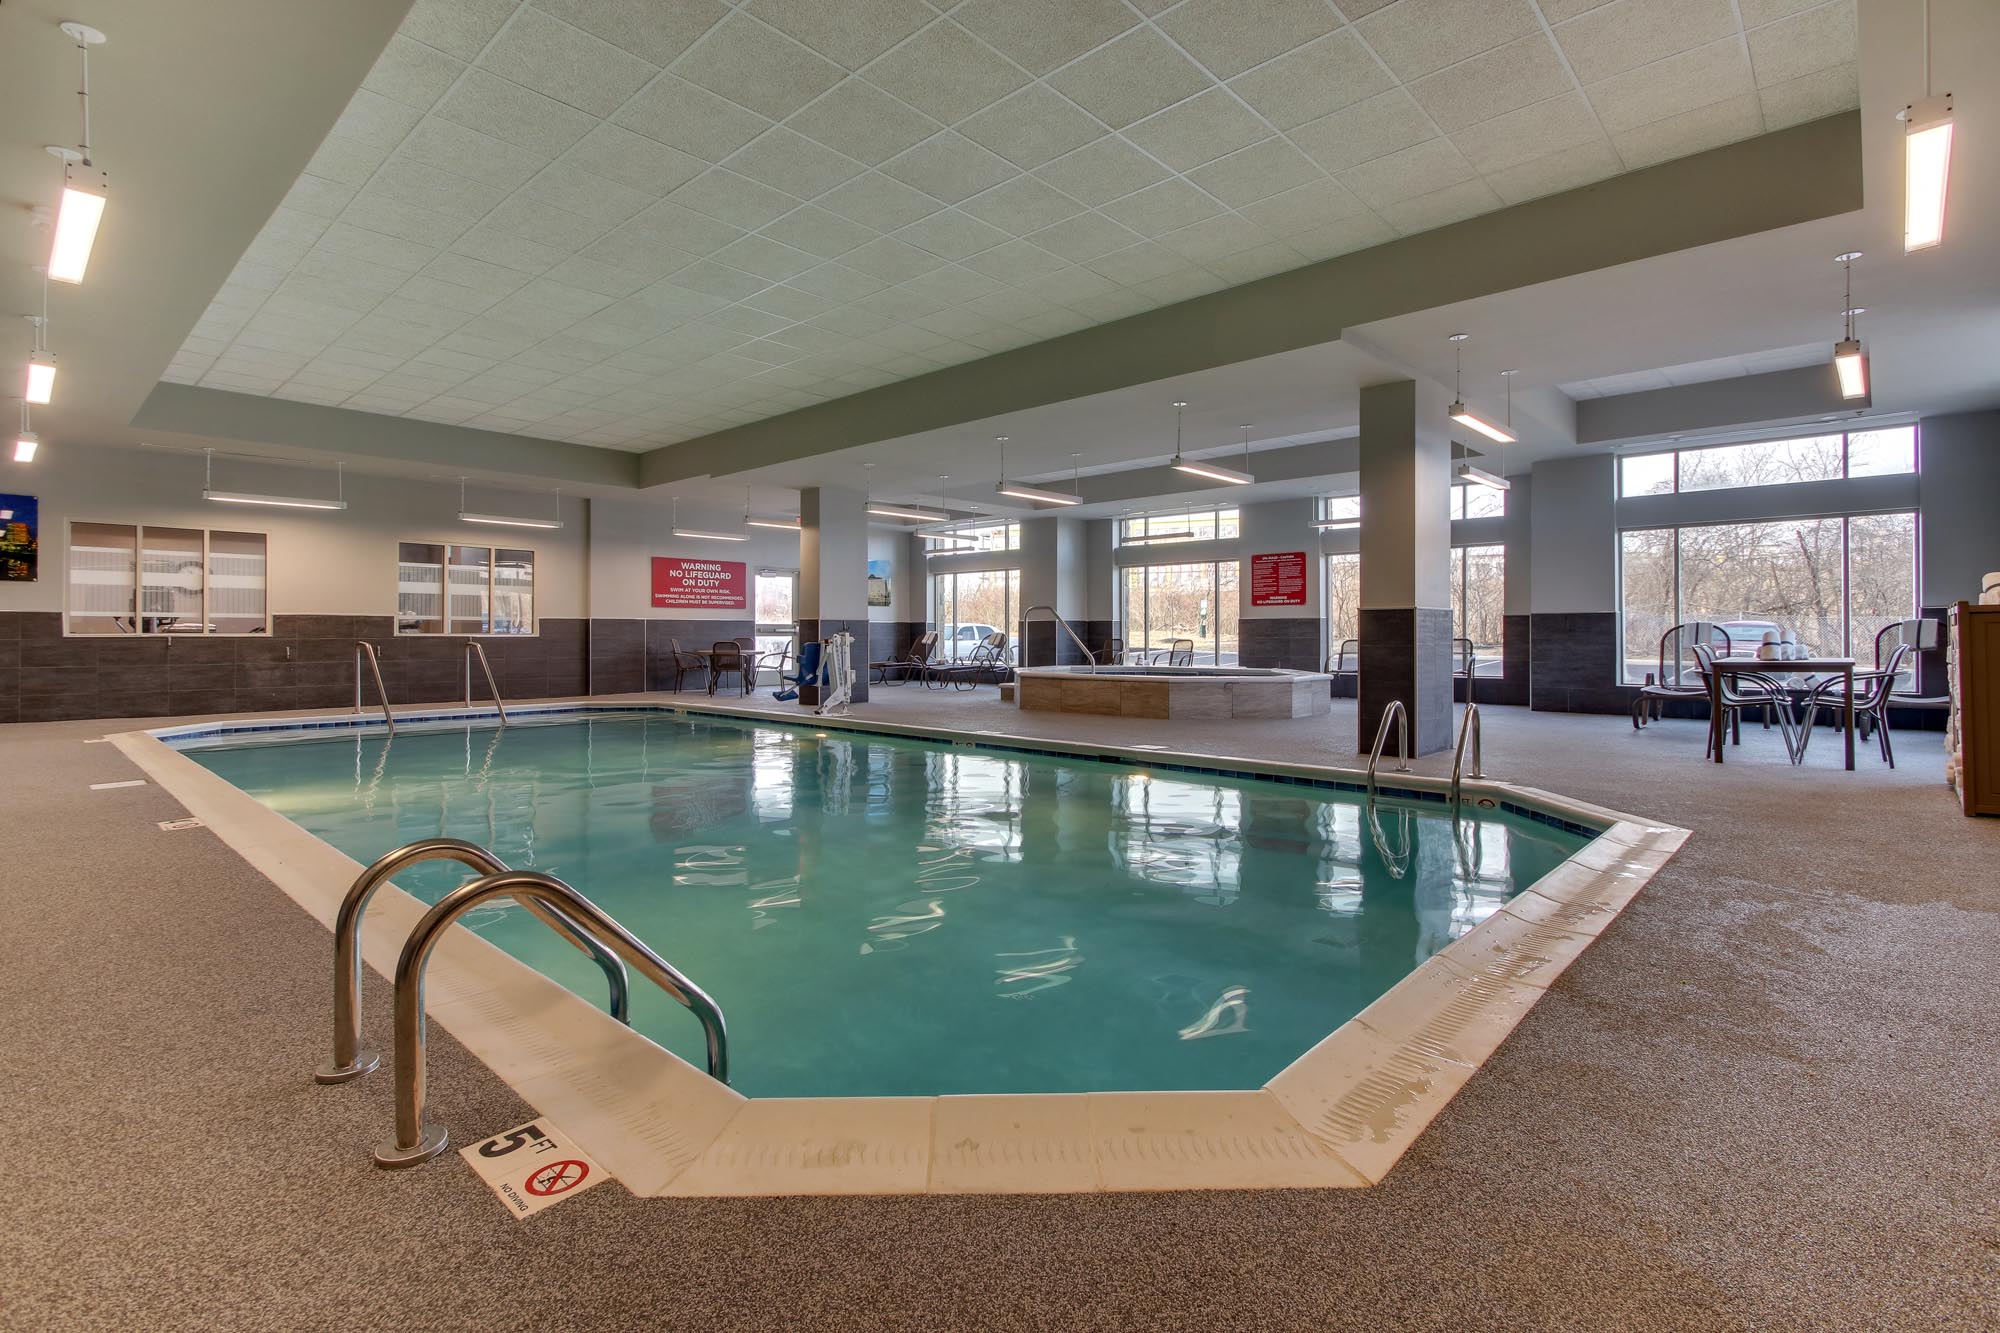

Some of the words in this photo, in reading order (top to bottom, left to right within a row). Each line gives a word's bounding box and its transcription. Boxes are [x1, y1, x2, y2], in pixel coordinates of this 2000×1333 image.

[681, 562, 721, 571] WARNING
[685, 571, 731, 580] LIFEGUARD
[478, 1124, 546, 1158] 5
[530, 1138, 558, 1154] FT
[500, 1183, 513, 1194] NO
[508, 1191, 529, 1212] DIVING
